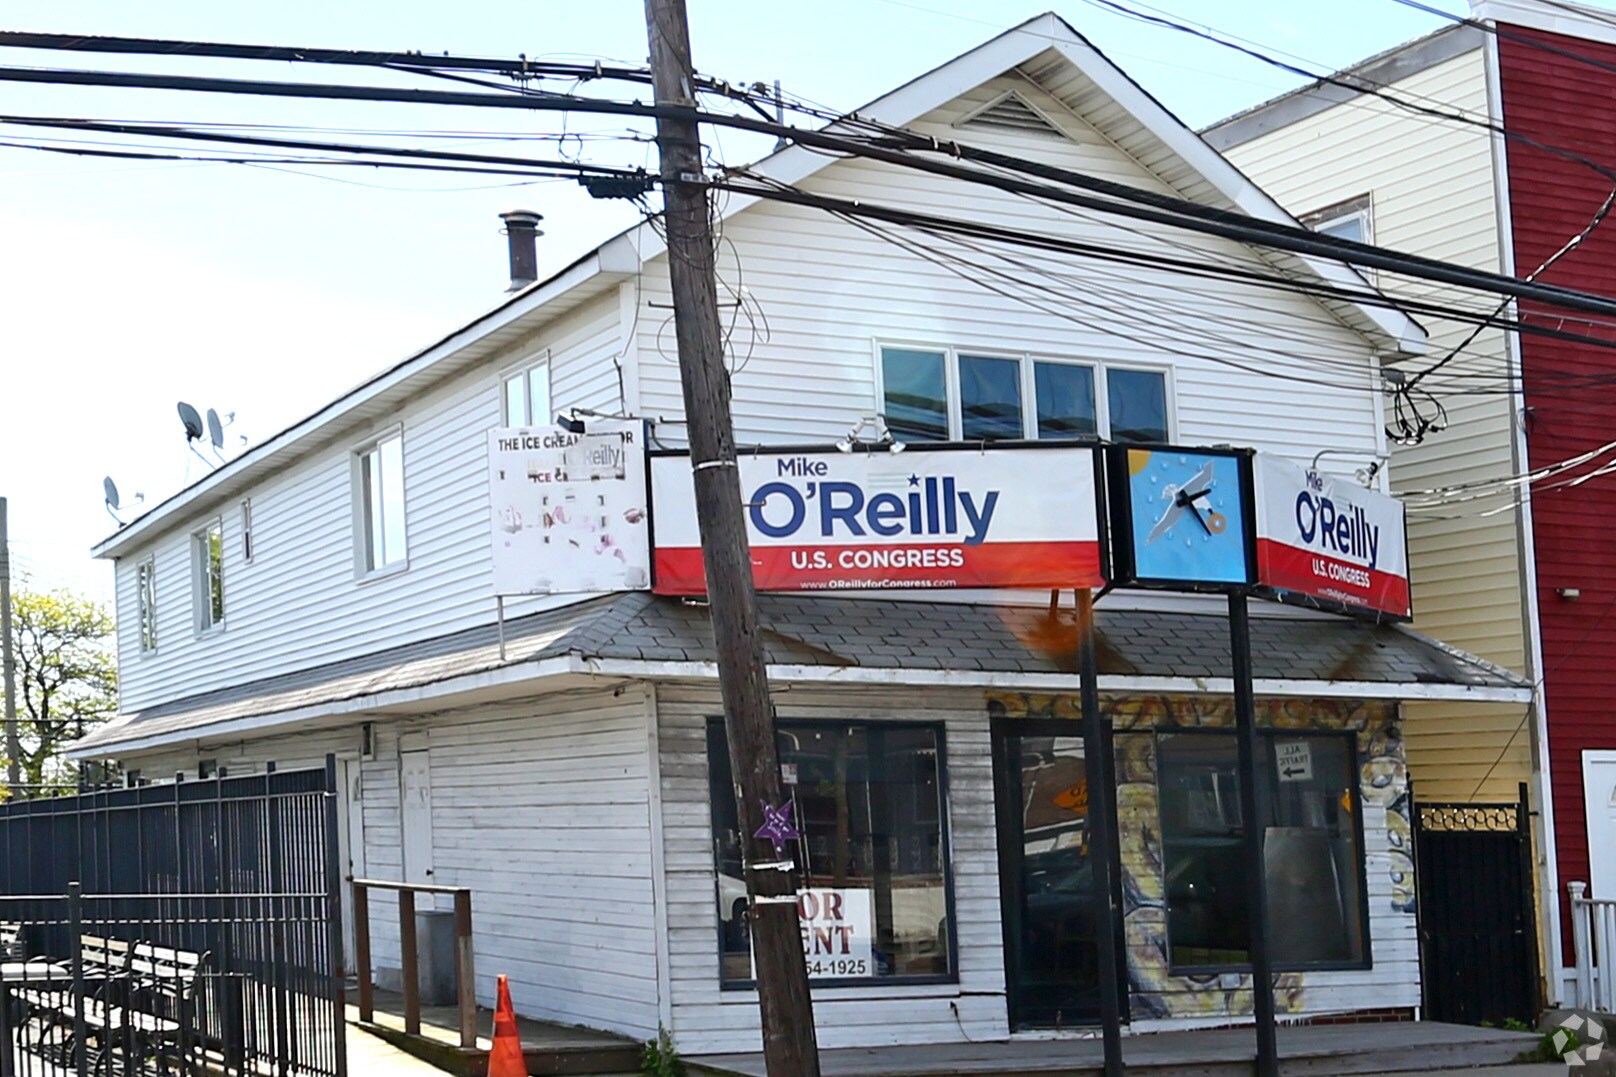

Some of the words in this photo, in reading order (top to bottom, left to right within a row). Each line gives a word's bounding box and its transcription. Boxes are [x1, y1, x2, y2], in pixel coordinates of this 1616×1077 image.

[498, 438, 519, 452] THE
[522, 436, 540, 450] ICE
[777, 457, 829, 477] Mike
[750, 475, 999, 546] O'Reilly
[1295, 490, 1379, 572] O'Reilly
[791, 550, 833, 570] U.S.
[838, 547, 965, 570] CONGRESS
[1312, 558, 1328, 578] U.S.
[1328, 562, 1371, 588] CONGRESS
[797, 892, 844, 921] OR
[800, 925, 854, 955] ENT
[806, 960, 866, 975] 54-1925
